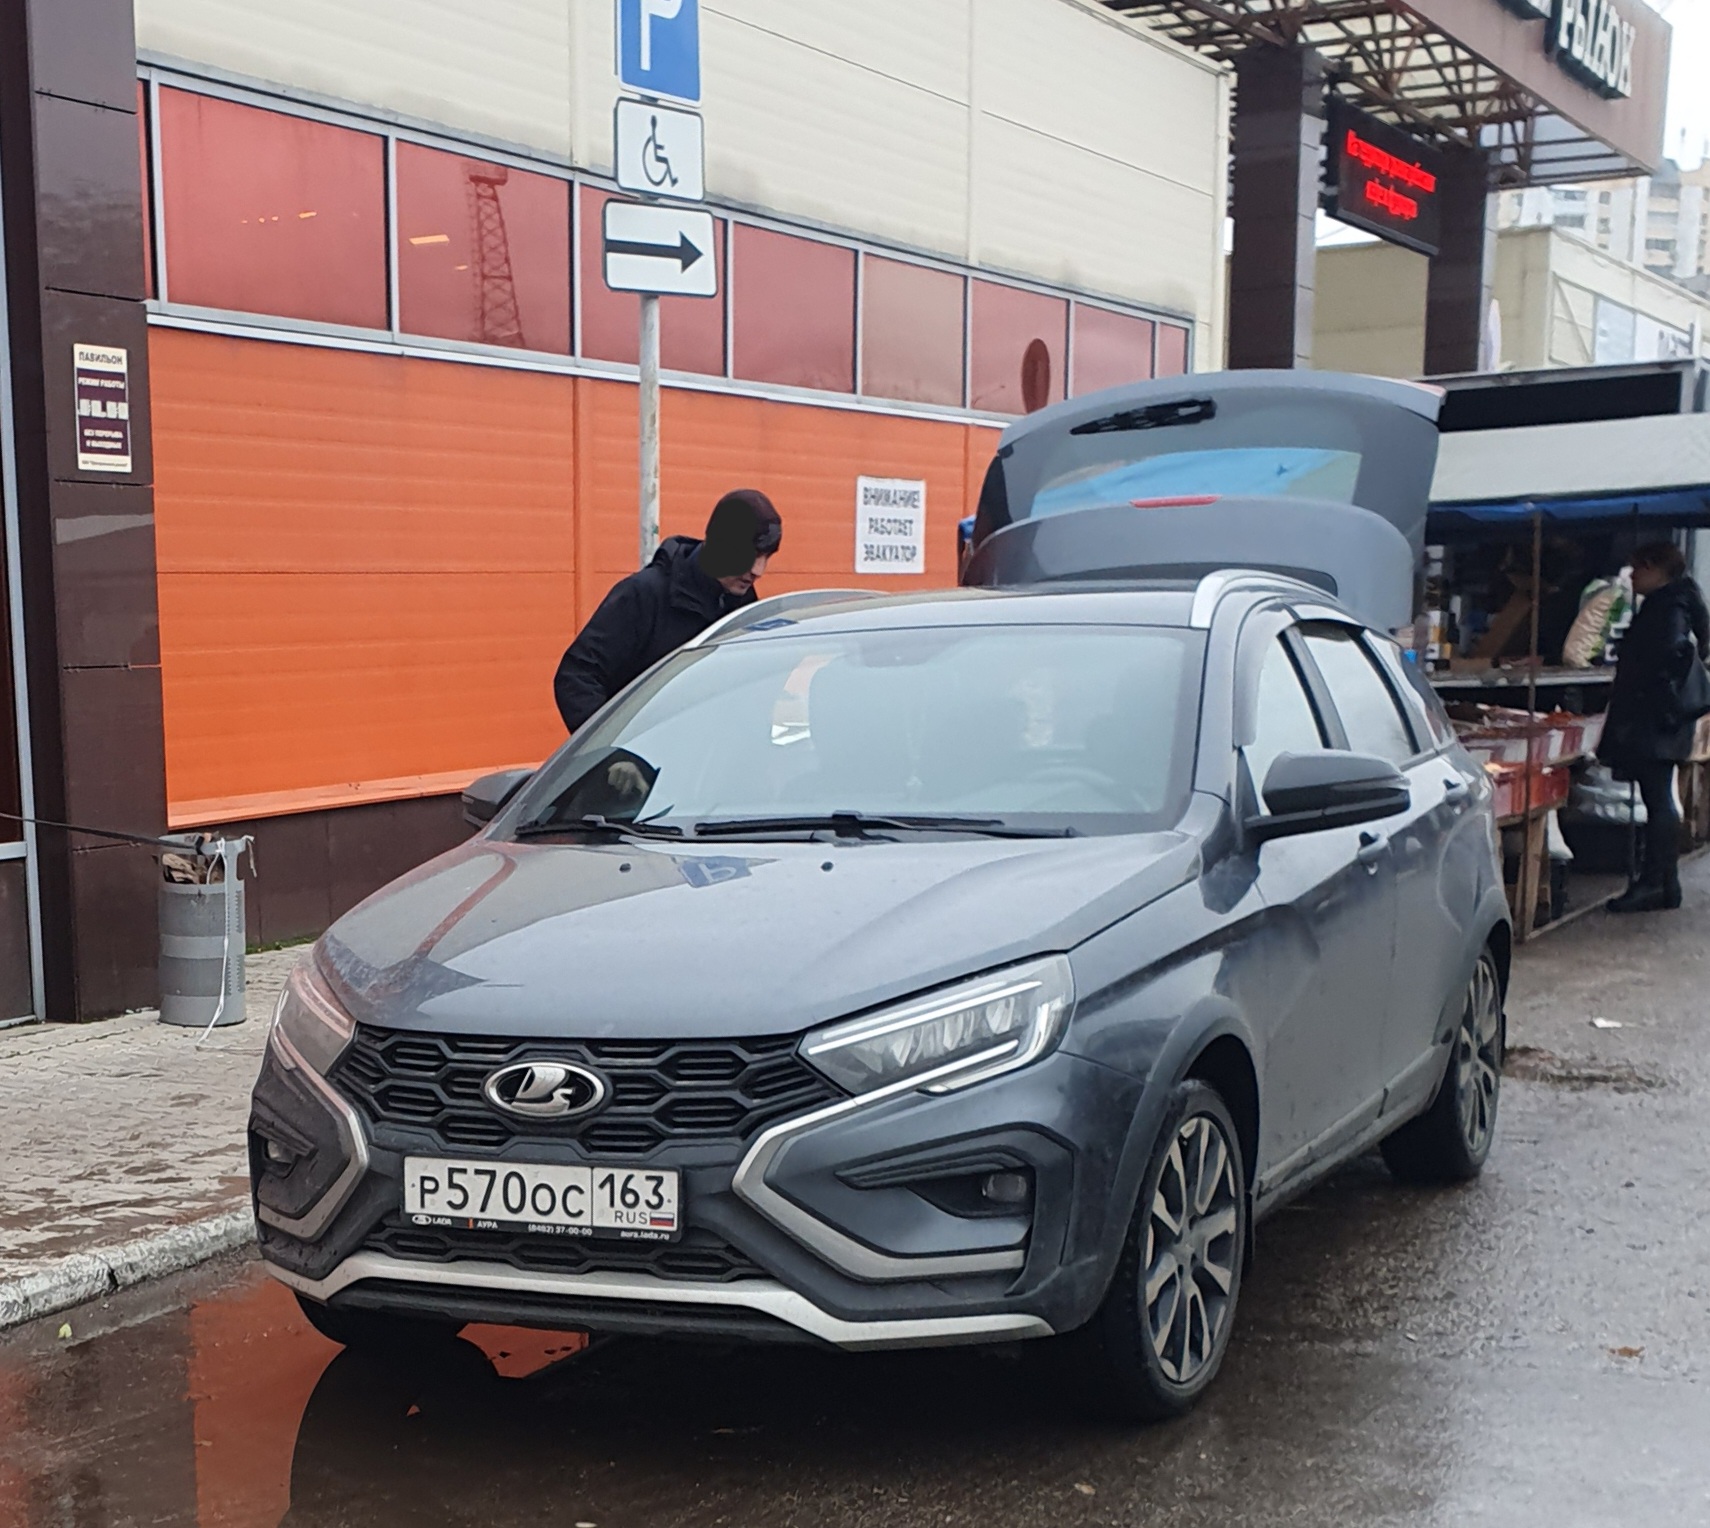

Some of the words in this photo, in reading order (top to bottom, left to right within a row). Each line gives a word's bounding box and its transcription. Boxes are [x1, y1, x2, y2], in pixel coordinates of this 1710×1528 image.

[78, 351, 123, 365] ПАВИЛЬОН
[863, 486, 920, 509] ВНИМАНИЕ
[863, 543, 917, 562] ЭВАКУАТОР
[419, 1166, 585, 1218] Р570ОС
[598, 1172, 665, 1210] 163
[614, 1210, 648, 1225] RUS
